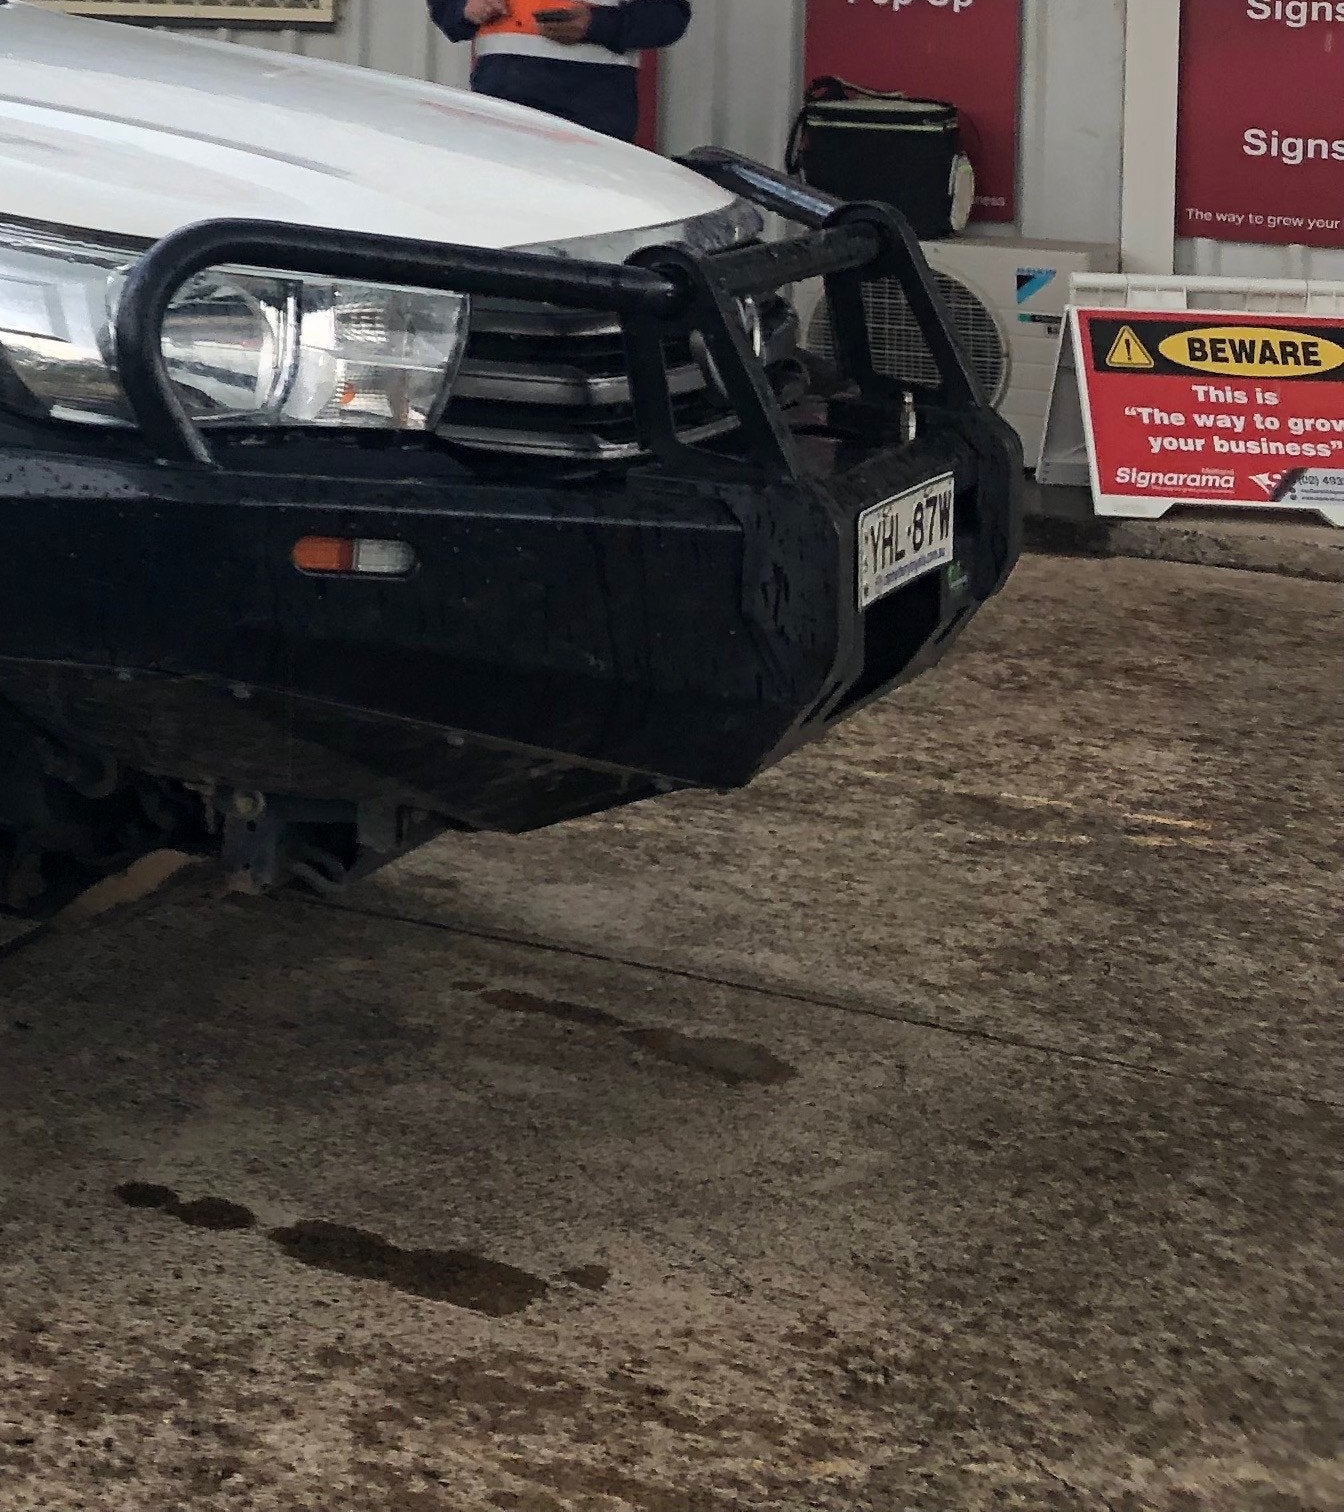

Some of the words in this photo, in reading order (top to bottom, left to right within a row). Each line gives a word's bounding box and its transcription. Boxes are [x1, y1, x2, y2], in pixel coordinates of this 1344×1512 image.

[1186, 207, 1213, 222] The
[1215, 212, 1245, 226] way
[1248, 212, 1264, 224] to
[1267, 215, 1304, 228] grow
[1307, 218, 1341, 230] your
[1186, 337, 1322, 367] BEWARE
[1191, 384, 1249, 404] This
[1254, 387, 1280, 406] is
[1192, 412, 1246, 433] way
[1252, 412, 1281, 430] to
[1148, 436, 1206, 454] your
[1115, 467, 1236, 488] Signarama
